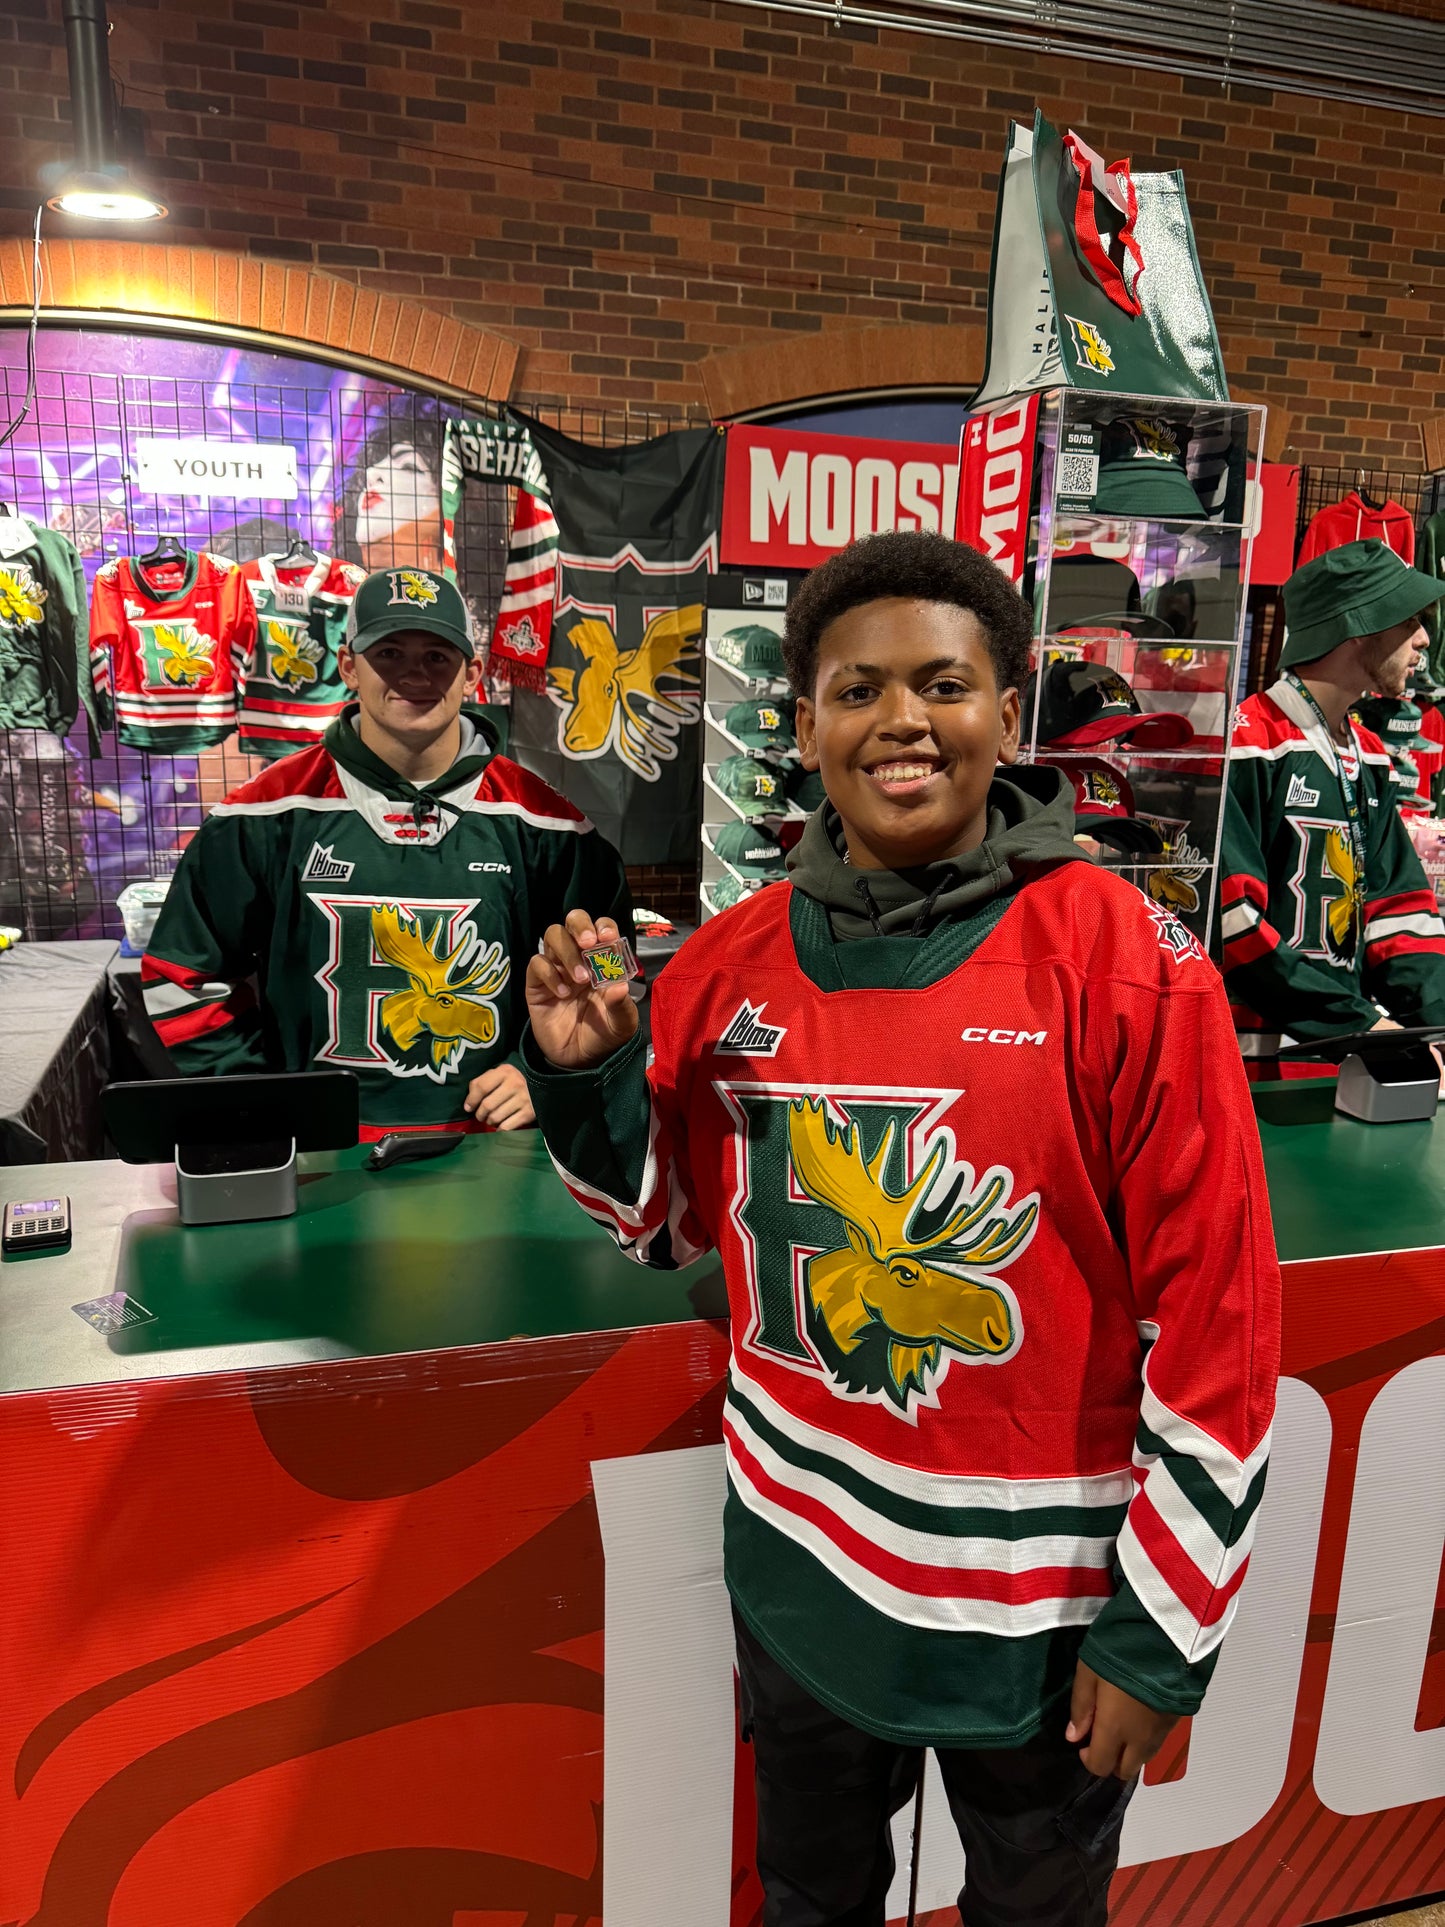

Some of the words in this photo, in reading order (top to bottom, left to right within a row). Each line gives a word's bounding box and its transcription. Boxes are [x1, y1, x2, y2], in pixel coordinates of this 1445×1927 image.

[1067, 433, 1094, 445] 50/50
[173, 458, 263, 479] YOUTH
[468, 862, 512, 874] CCM
[960, 1027, 1048, 1045] CCM
